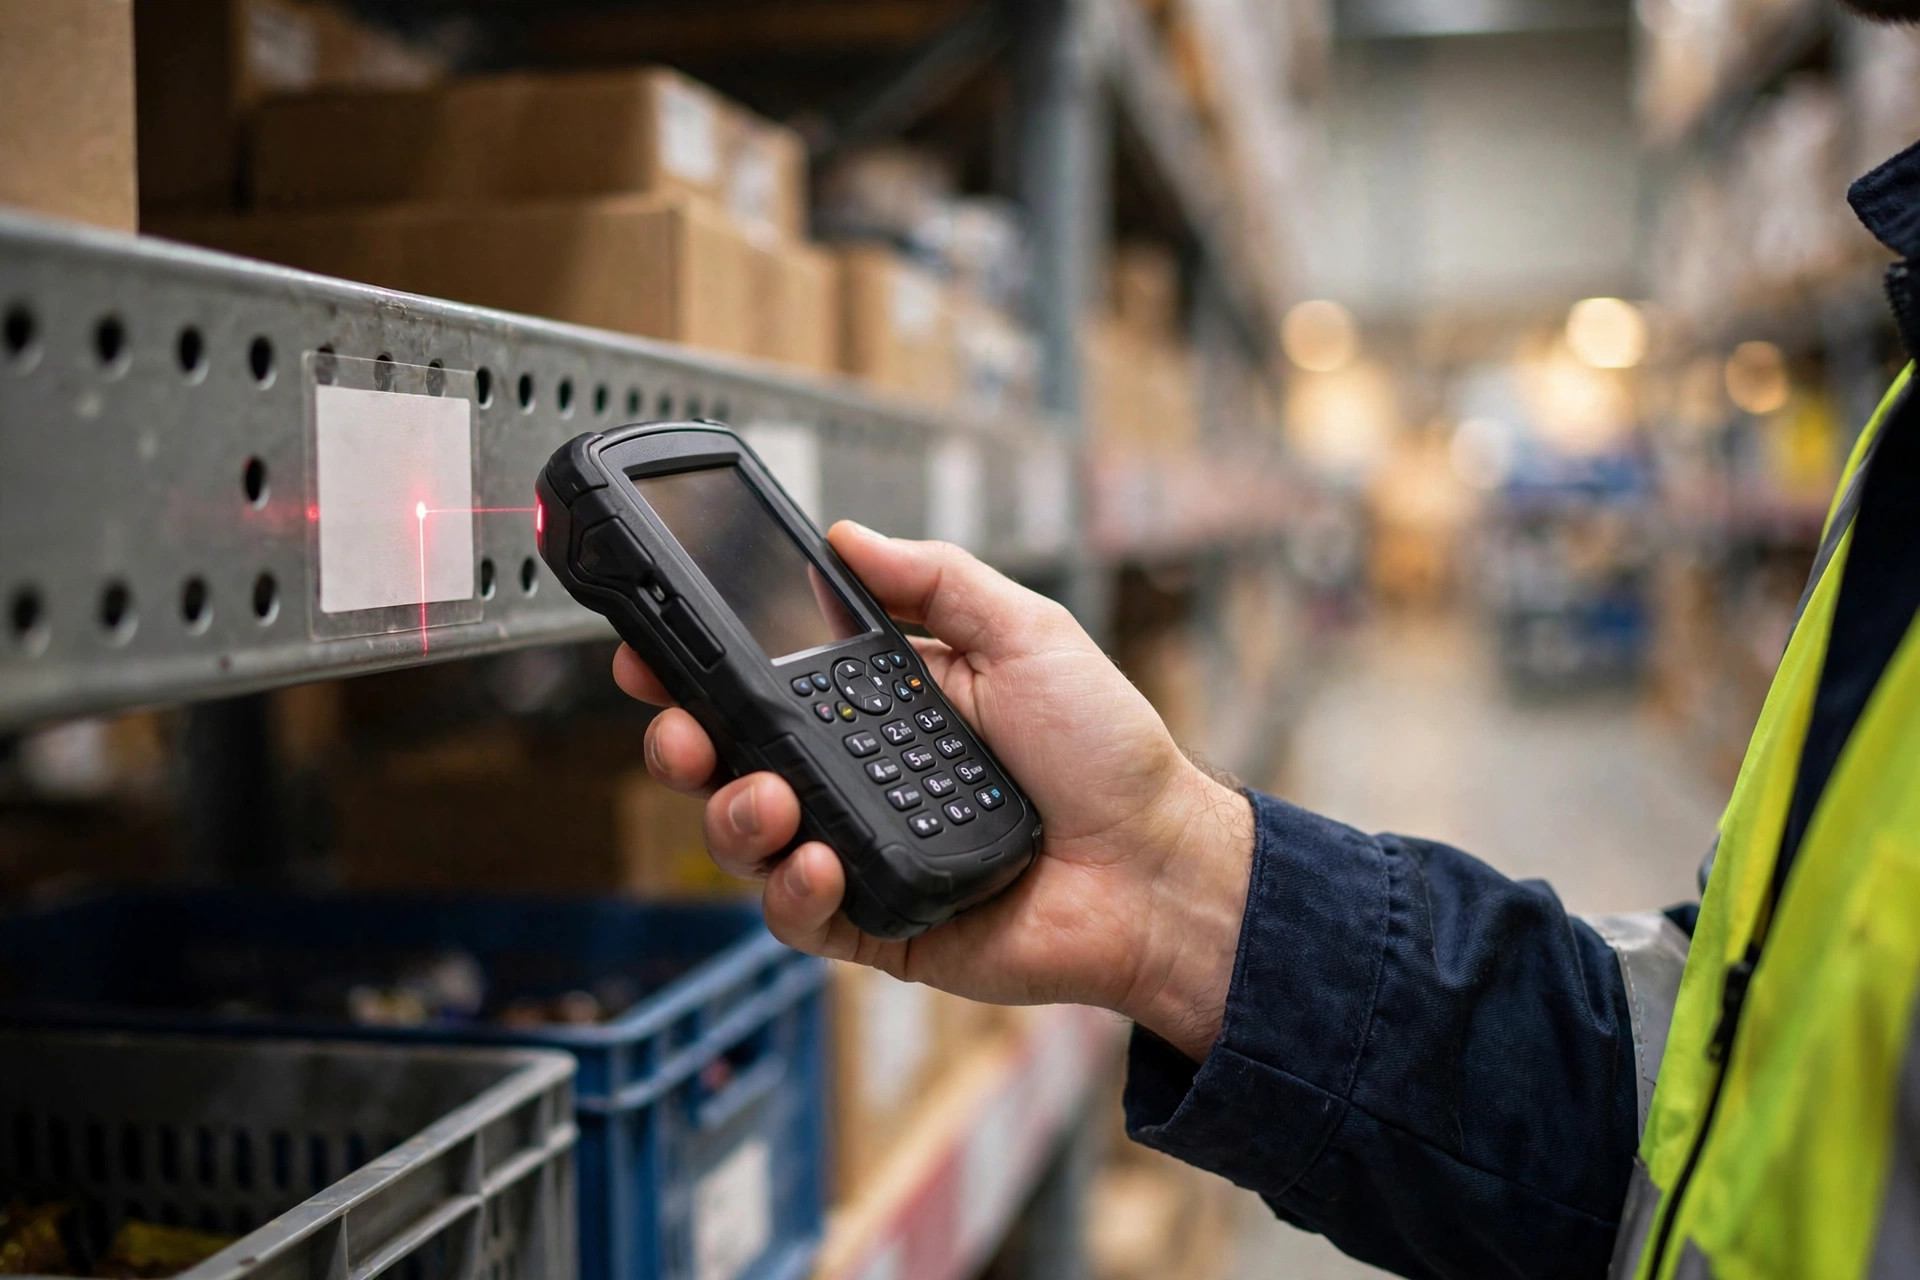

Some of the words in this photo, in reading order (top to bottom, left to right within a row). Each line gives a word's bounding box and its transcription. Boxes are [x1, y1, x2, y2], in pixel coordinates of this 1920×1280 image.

[920, 714, 932, 728] 3
[887, 726, 902, 741] 2
[852, 738, 864, 752] 1
[941, 740, 953, 753] 6
[908, 752, 921, 766] 5
[960, 767, 972, 780] 9
[929, 779, 941, 792] 8
[892, 791, 905, 806] 7
